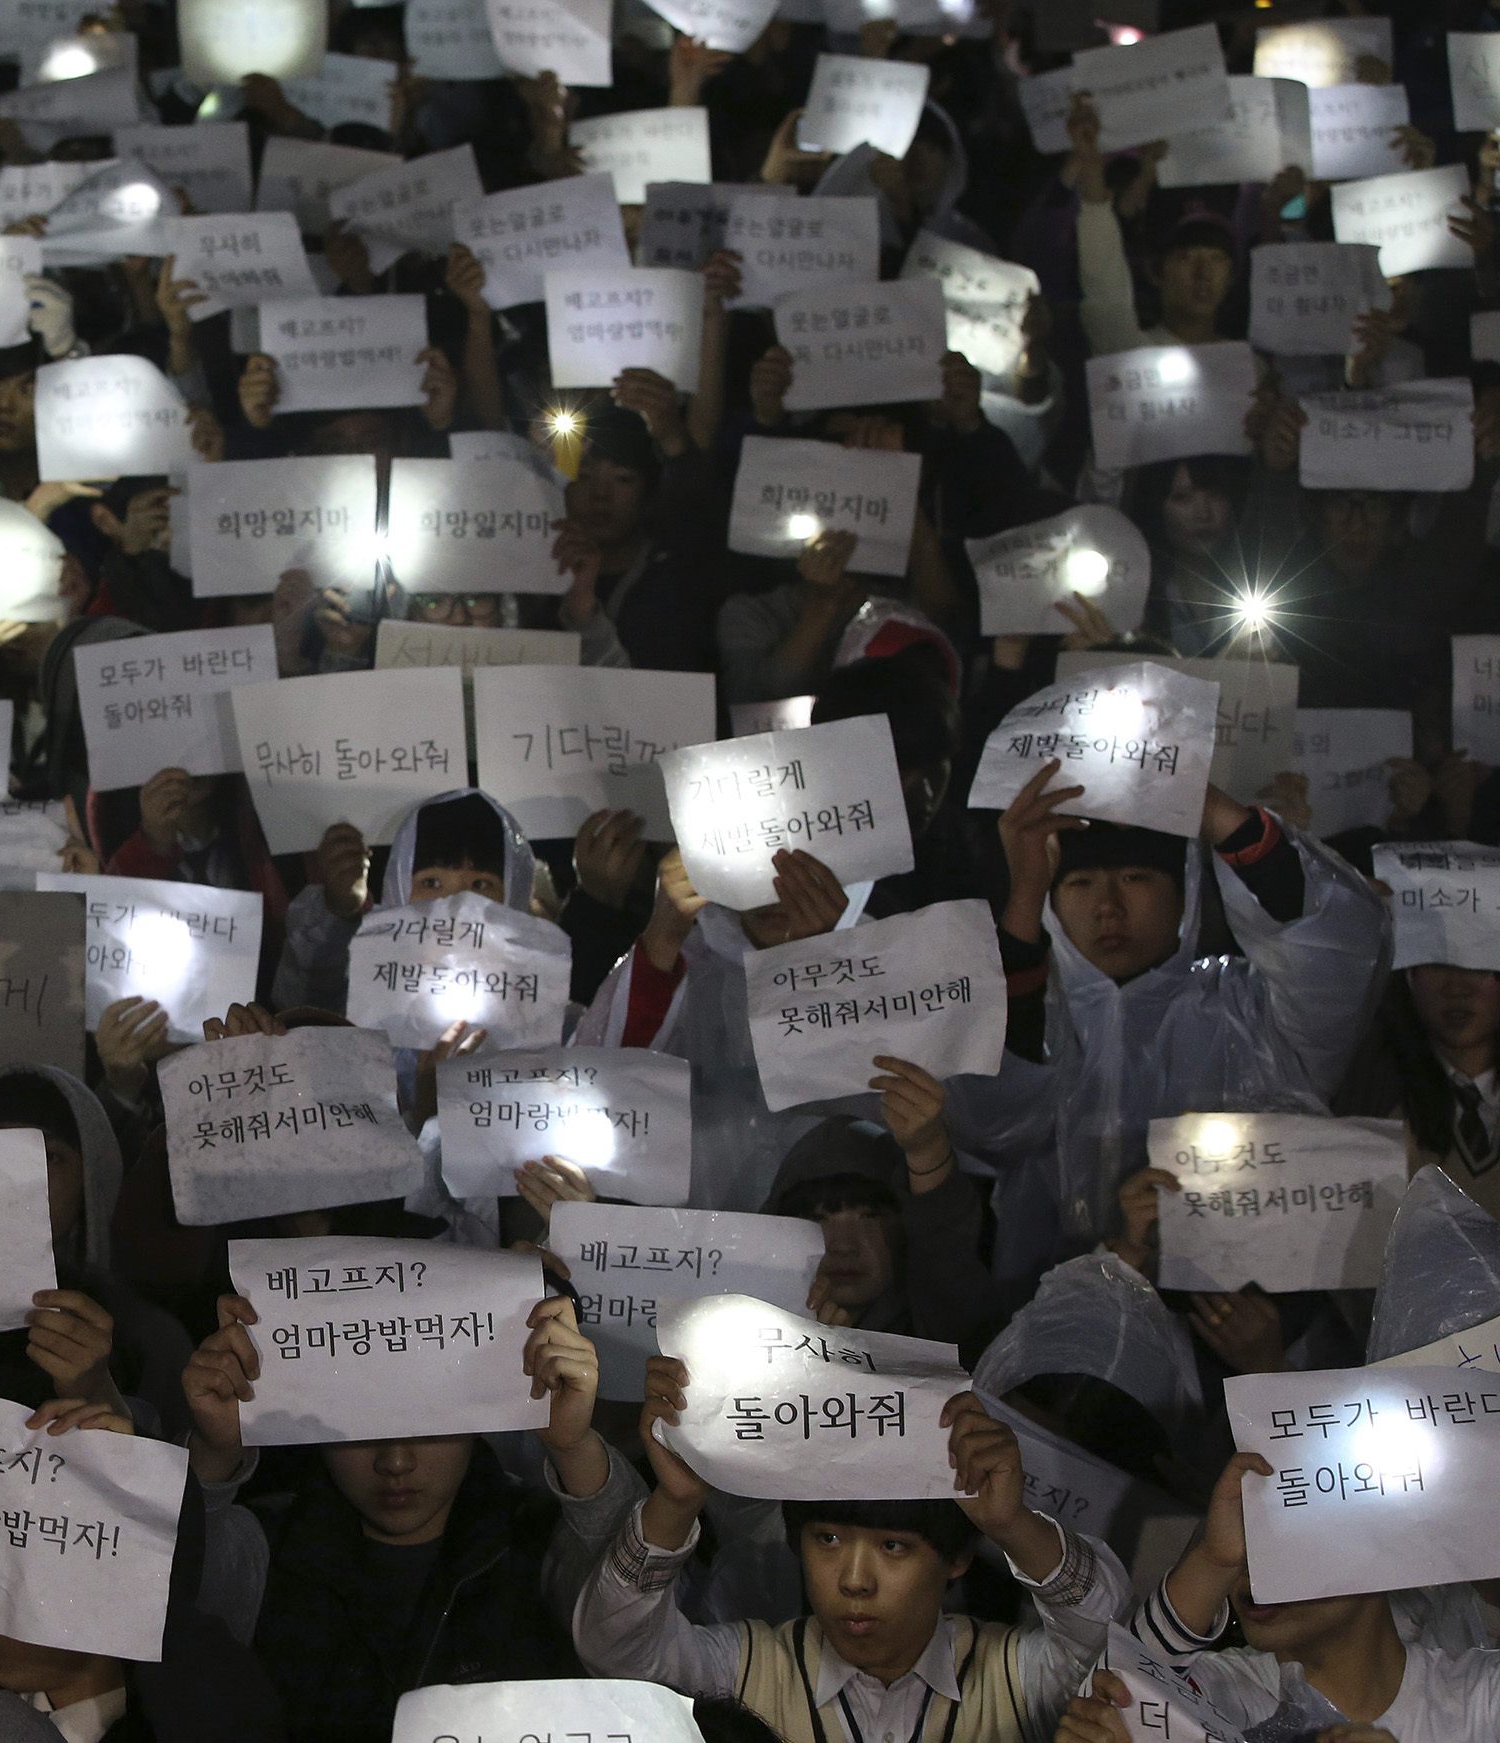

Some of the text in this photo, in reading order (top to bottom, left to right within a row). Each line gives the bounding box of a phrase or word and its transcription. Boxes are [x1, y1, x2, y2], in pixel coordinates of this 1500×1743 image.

[99, 648, 254, 690] 모두가 바란다
[102, 692, 193, 730] 돌아와줘
[86, 902, 138, 928] 두가
[1400, 887, 1482, 914] 미소가
[772, 954, 888, 994] 아무것도
[777, 974, 974, 1038] 못해줘서미안해
[187, 1061, 297, 1106] 아무것도
[192, 1099, 381, 1151] 못해줘서미안해
[1183, 1179, 1376, 1219] 못해줘서미안해
[580, 1239, 725, 1280] 배고프지?
[266, 1260, 430, 1301] 배고프지?
[271, 1311, 496, 1361] 엄마랑밥먹자!
[725, 1389, 909, 1442] 돌아와줘
[1268, 1397, 1379, 1443] 모두가
[1138, 1701, 1171, 1741] 더
